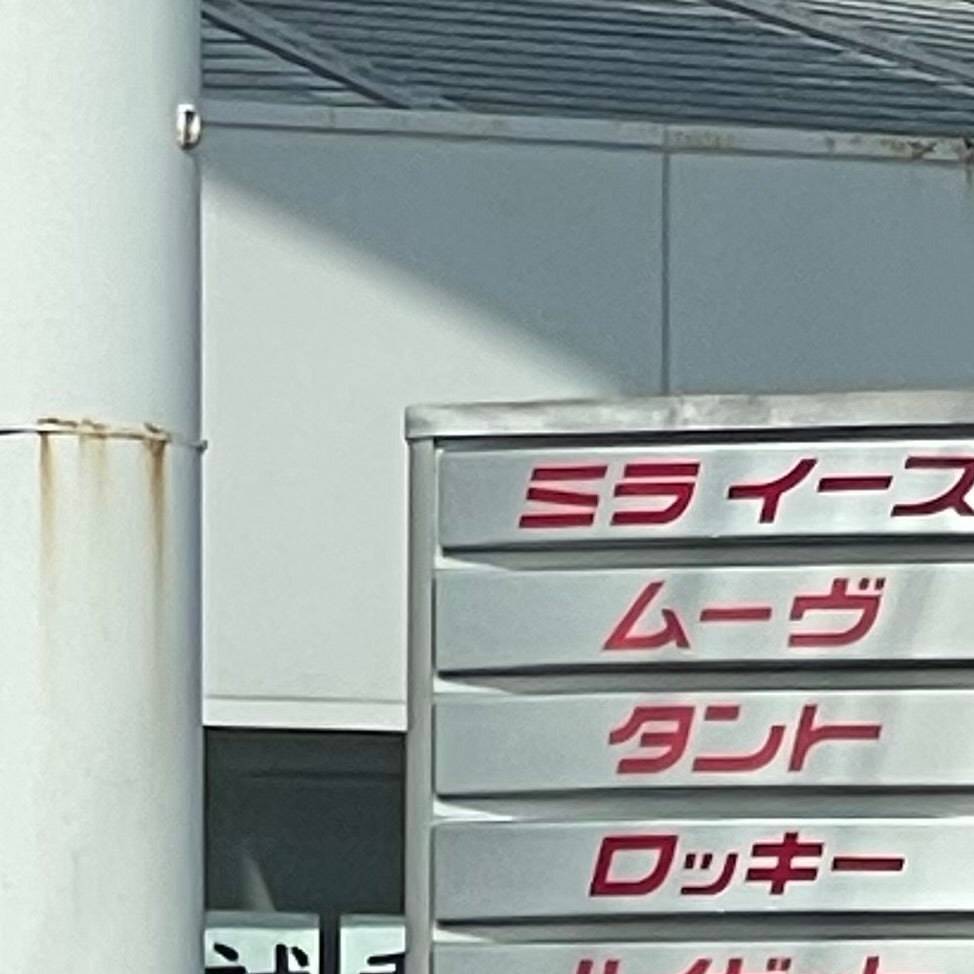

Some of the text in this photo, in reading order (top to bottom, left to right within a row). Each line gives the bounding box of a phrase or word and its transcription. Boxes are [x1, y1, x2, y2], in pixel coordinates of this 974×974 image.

[518, 460, 701, 529] ミラ
[603, 577, 886, 652] ムーヴ
[608, 703, 882, 775] タント
[588, 831, 905, 898] ロッキー
